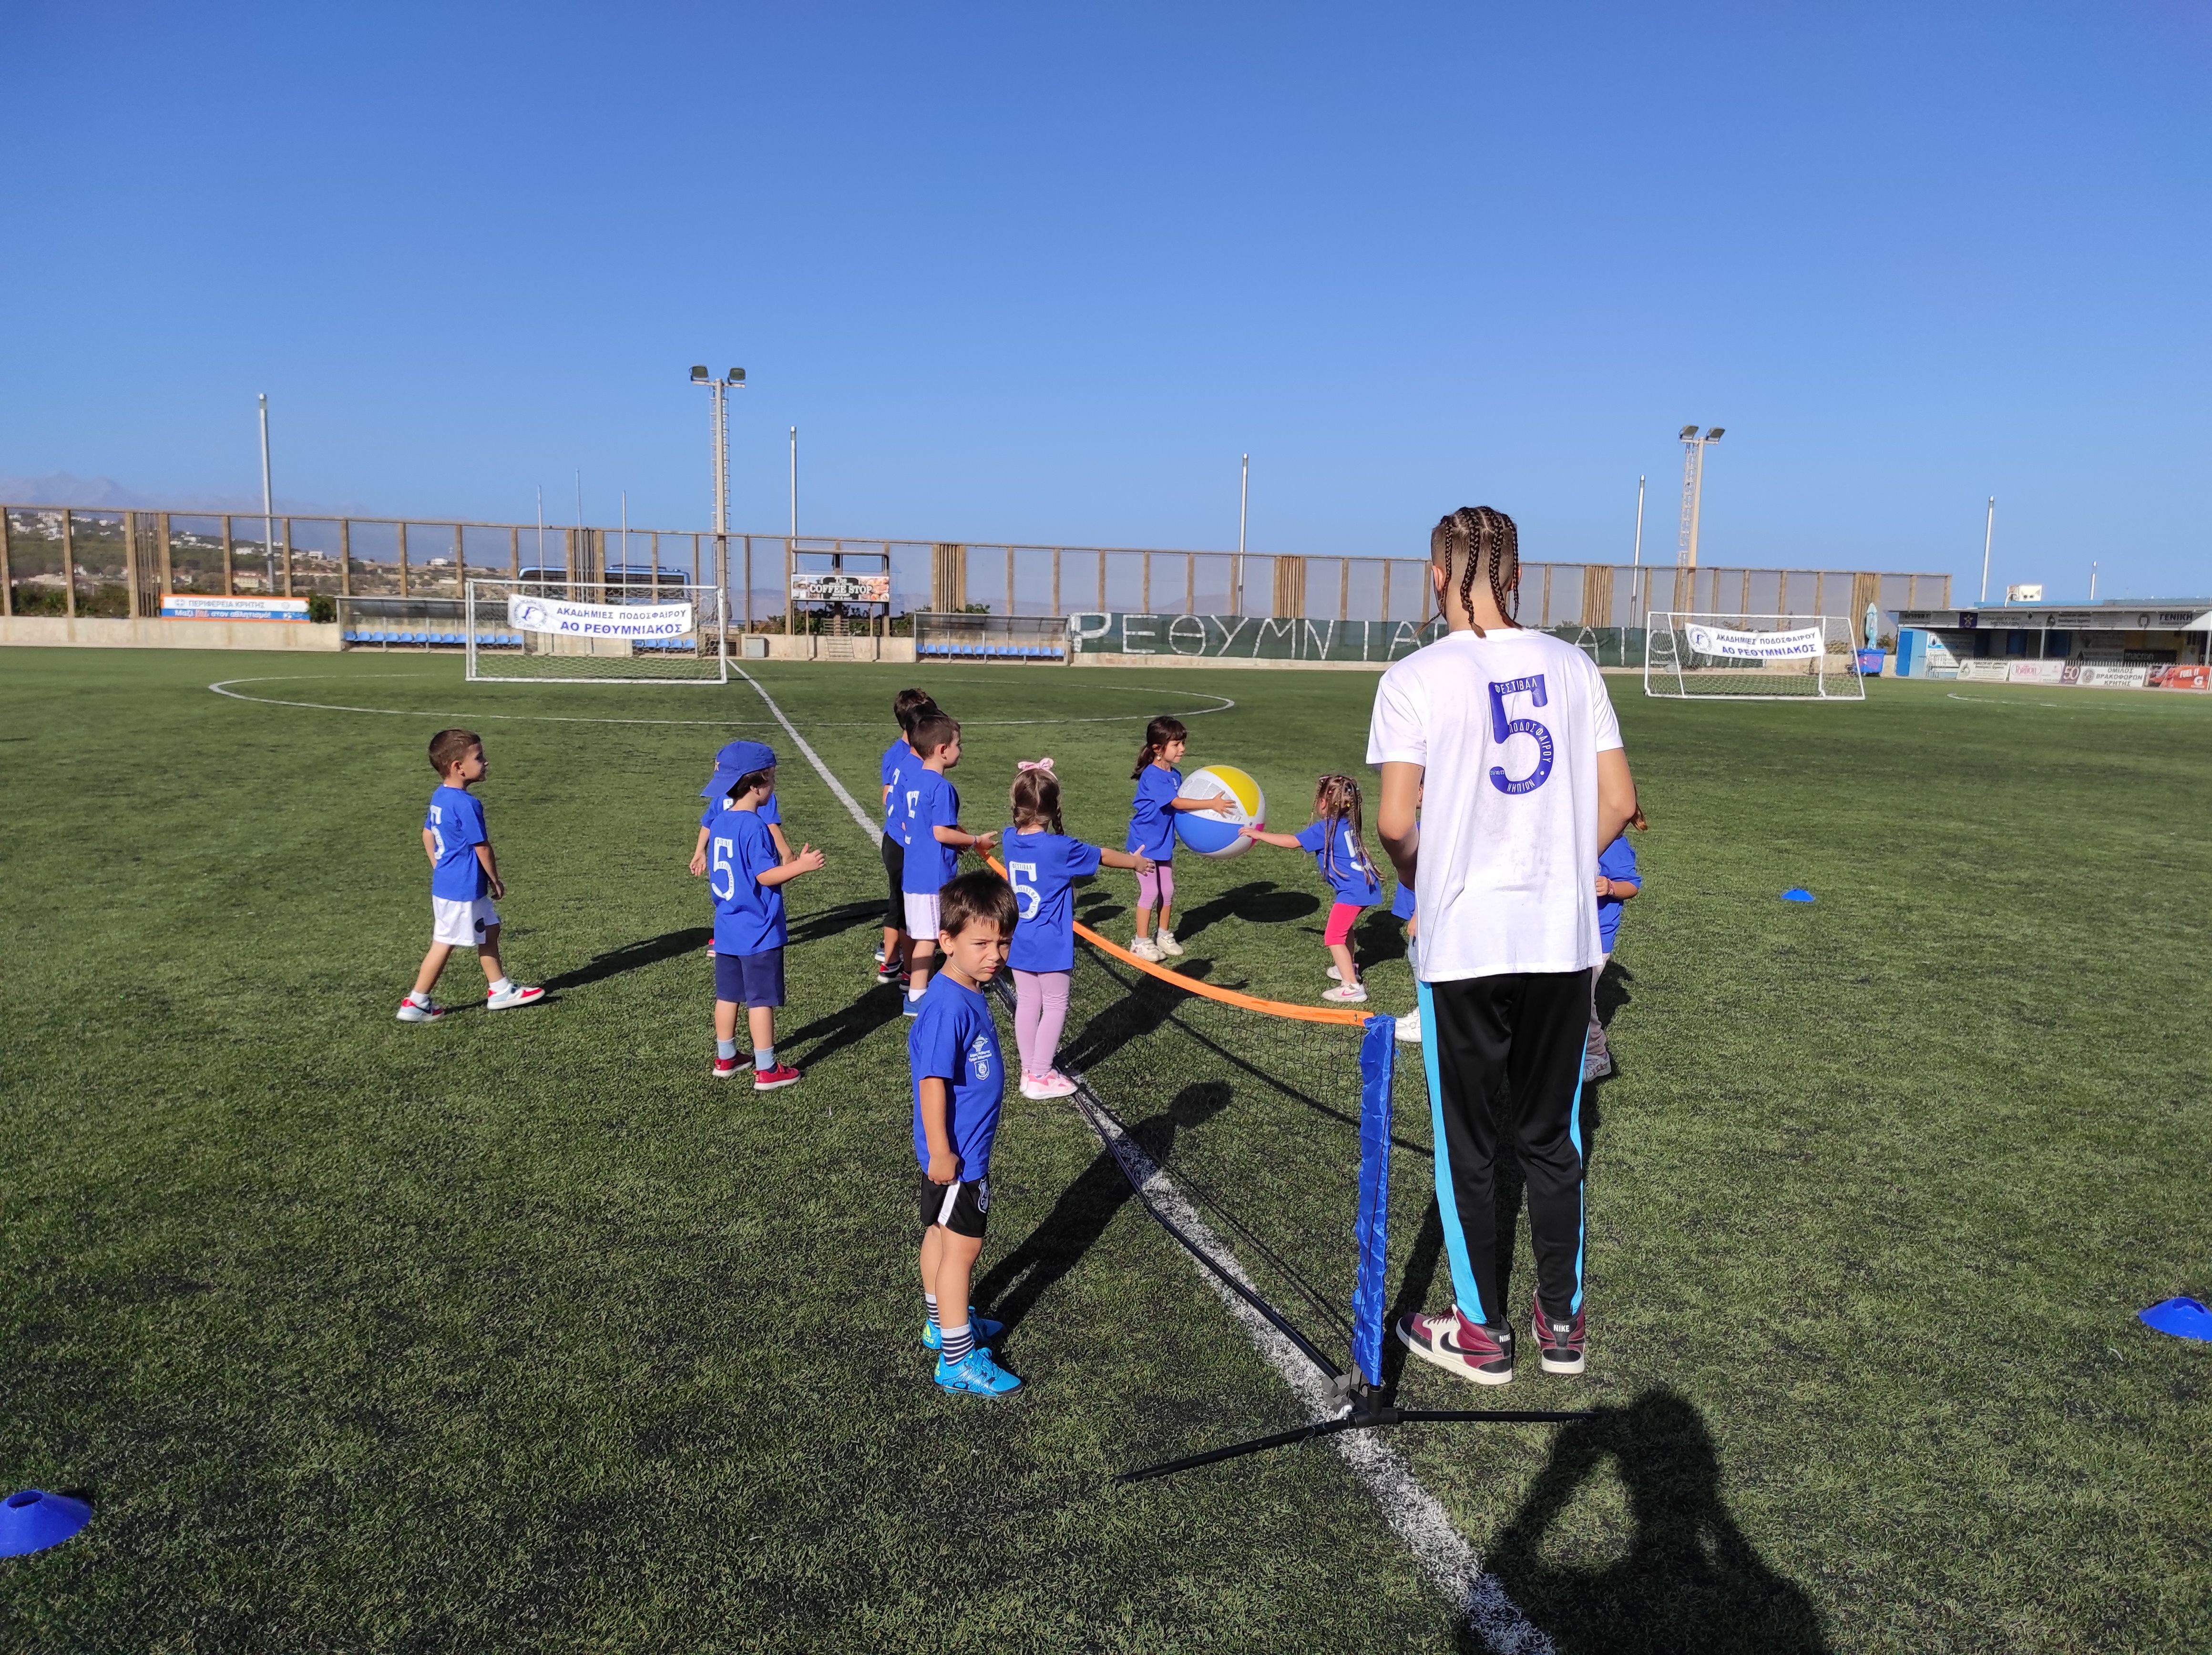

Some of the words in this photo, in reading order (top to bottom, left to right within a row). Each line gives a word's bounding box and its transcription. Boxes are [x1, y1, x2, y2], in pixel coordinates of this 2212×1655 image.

[809, 584, 846, 593] COFFEE
[848, 585, 872, 594] STOP
[556, 607, 614, 619] ΑΚΑΔΗΜΙΕΣ
[619, 610, 686, 620] ΠΟΔΟΣΦΑΙΡΟΥ
[560, 621, 580, 631] ΑΟ
[584, 623, 683, 635] ΡΕΘΥΜΝΙΑΚΟΣ
[1716, 633, 1756, 645] ΑΚΑΔΗΜΙΕΣ
[1760, 632, 1815, 644] ΠΟΔΟΣΦΑΙΡΟΥ
[1722, 646, 1735, 654] ΑΟ
[1739, 644, 1817, 657] ΡΕΘΥΜΝΙΑΚΟΣ
[2063, 665, 2079, 681] 50
[1494, 677, 1537, 694] ΦΕΣΤΙΒΑΛ
[1488, 674, 1554, 795] 5
[1508, 721, 1552, 763] ΠΟΔΟΣΦΑΙΡΟΥ
[1506, 778, 1536, 793] ΝΗΠΙΩΝ
[711, 837, 734, 901] 5
[1009, 861, 1041, 919] 5
[1553, 1324, 1570, 1332] NIKE
